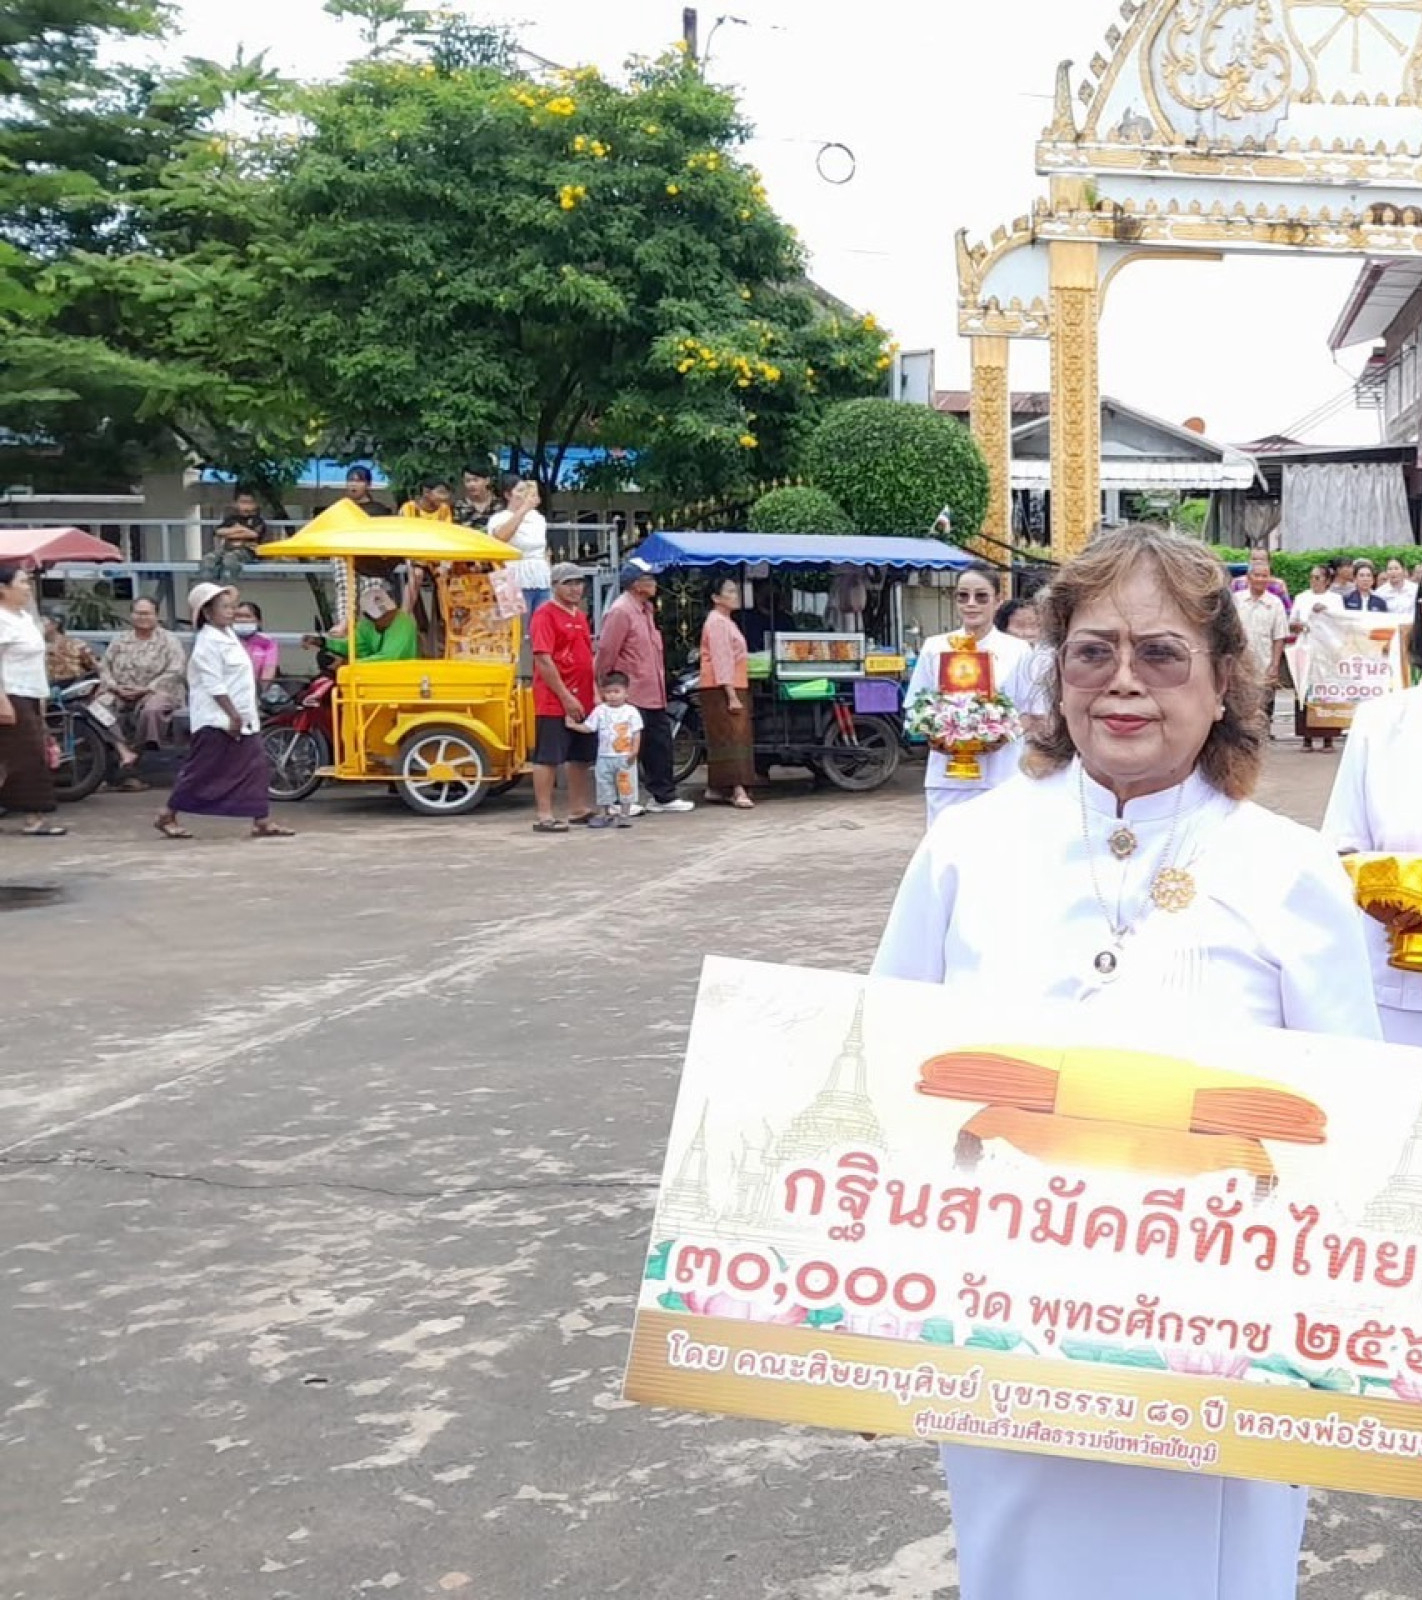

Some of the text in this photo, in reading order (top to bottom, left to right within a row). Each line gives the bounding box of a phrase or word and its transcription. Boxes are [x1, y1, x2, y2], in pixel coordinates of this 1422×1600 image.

[784, 1150, 1418, 1289] กฐินสามัคคีทั่วไทย
[675, 1243, 937, 1313] ๓๐,๐๐๐
[958, 1273, 1011, 1323] วัด
[1029, 1294, 1271, 1352] พุทธศักราช
[668, 1333, 725, 1368] โดย
[738, 1350, 980, 1400] คณะศิษยานุศิษย์
[1204, 1400, 1226, 1428] ปี
